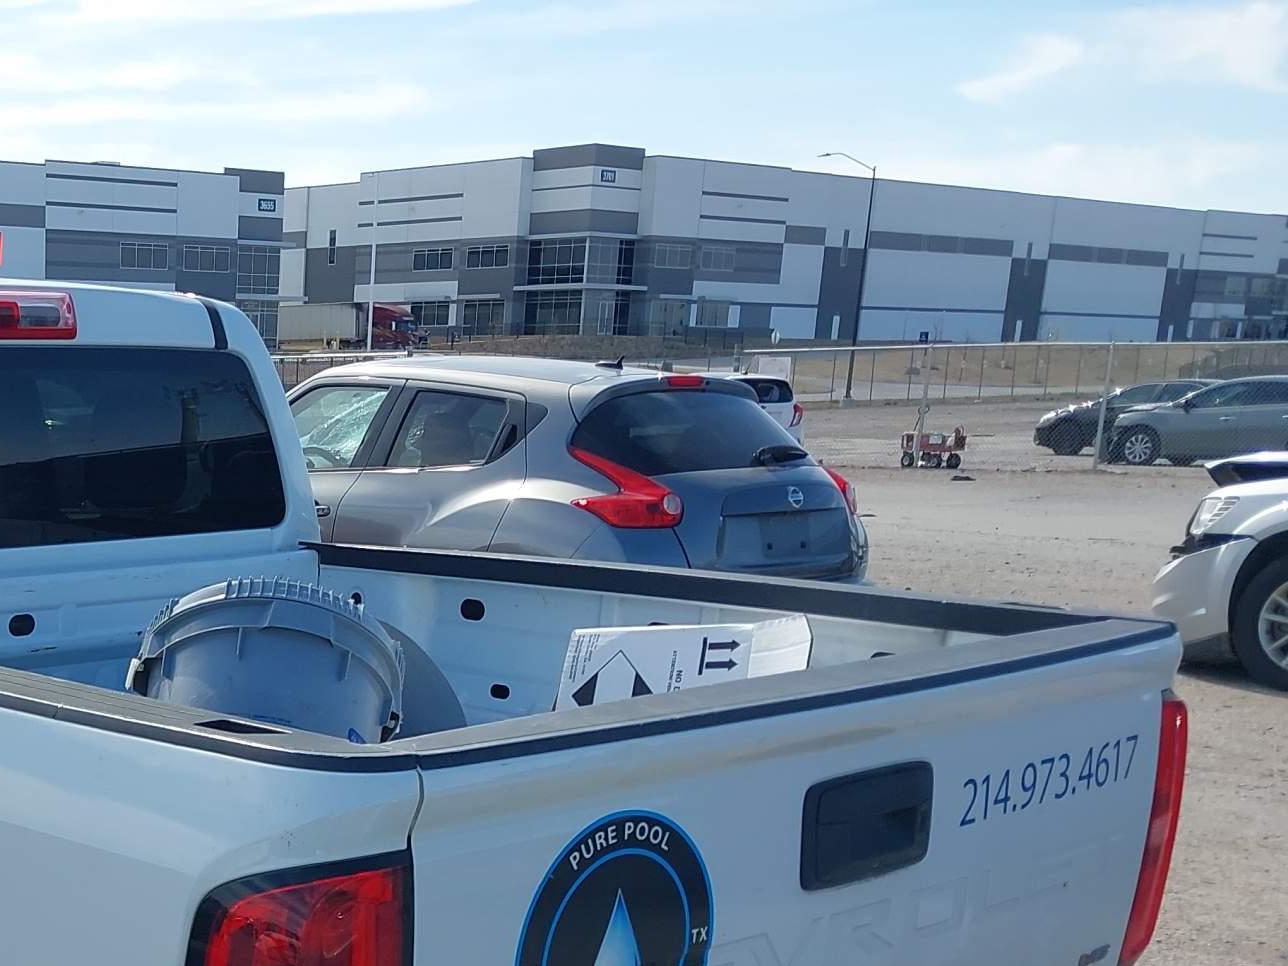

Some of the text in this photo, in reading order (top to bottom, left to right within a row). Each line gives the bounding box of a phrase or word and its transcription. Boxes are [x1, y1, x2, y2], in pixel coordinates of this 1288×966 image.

[674, 669, 684, 684] NO
[959, 734, 1139, 827] 214.973.4617
[568, 822, 670, 871] PURE POOL
[691, 926, 709, 944] TX
